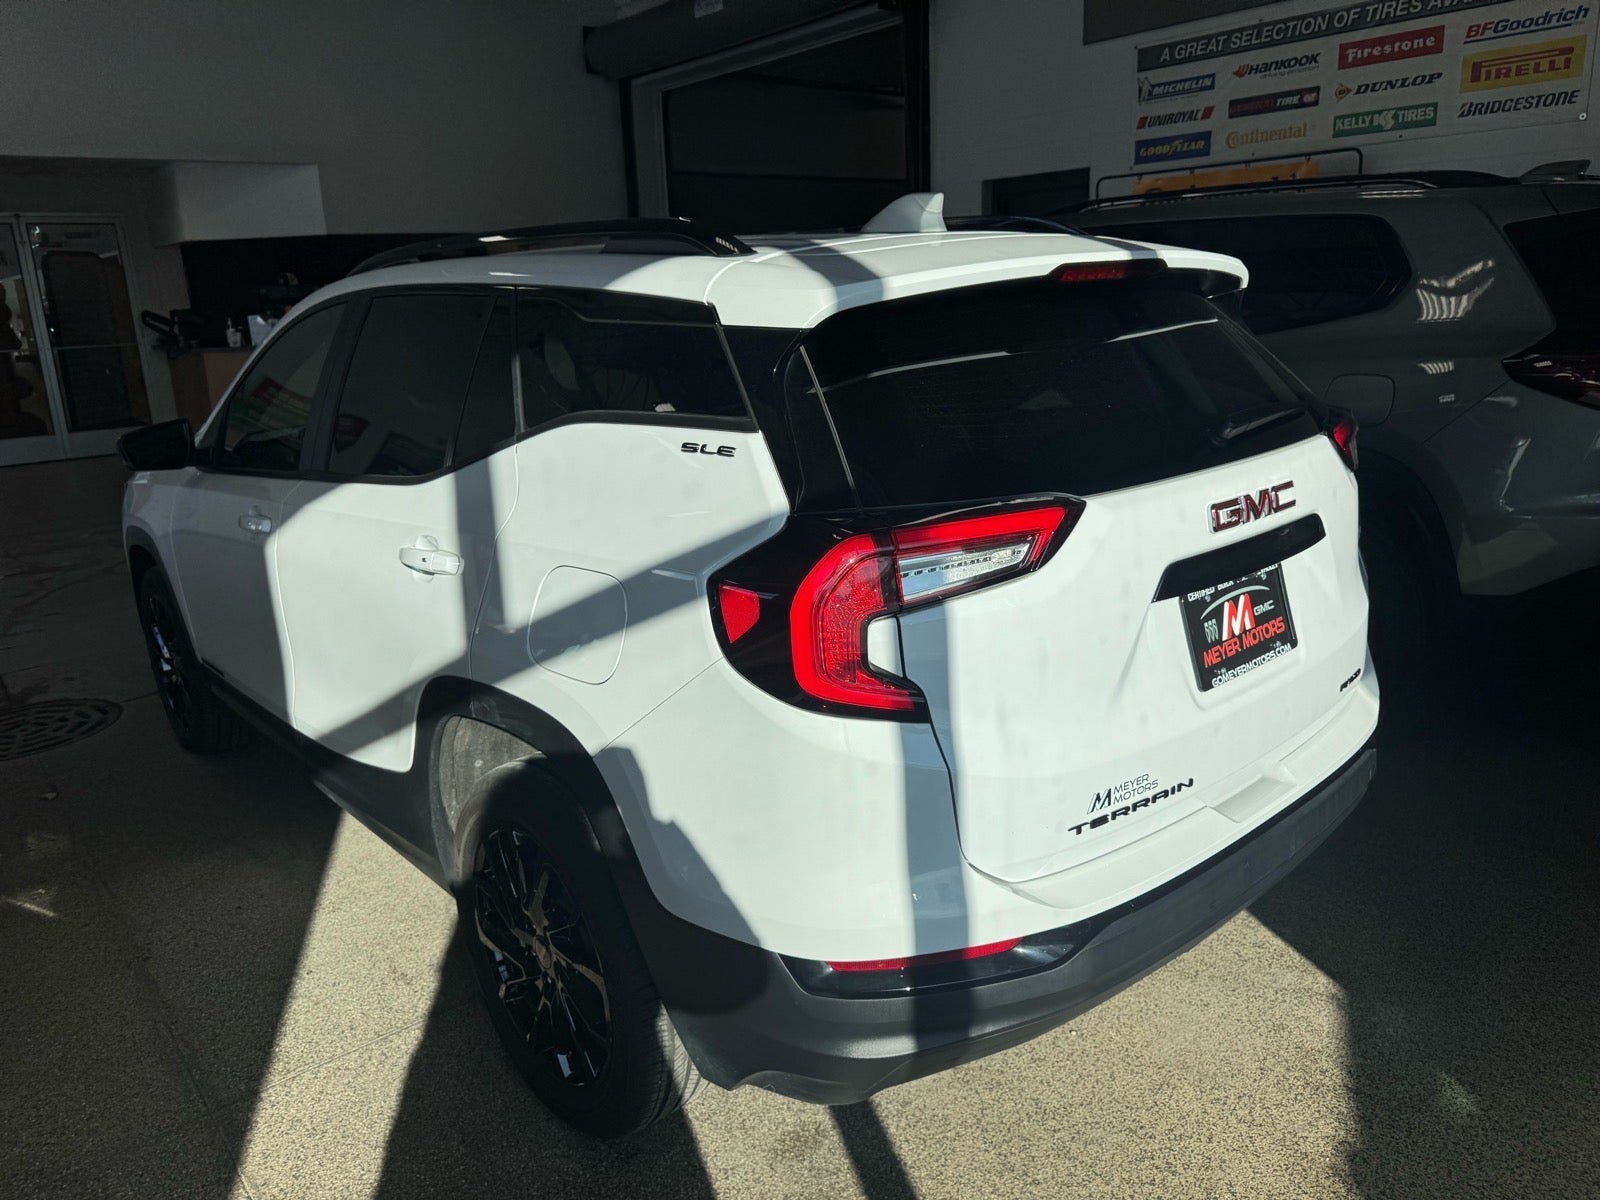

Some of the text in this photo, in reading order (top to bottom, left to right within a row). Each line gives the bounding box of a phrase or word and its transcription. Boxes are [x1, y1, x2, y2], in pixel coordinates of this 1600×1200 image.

[1159, 48, 1170, 63] A
[1174, 35, 1230, 59] GREAT
[1230, 14, 1329, 49] SELECTION
[1333, 8, 1360, 28] OF
[1366, 0, 1423, 22] TIRES
[1465, 5, 1589, 39] BFGoodrich
[1346, 34, 1436, 63] Firestone
[1470, 47, 1575, 83] PIRELLI
[1152, 76, 1213, 96] MICHELIN
[1354, 72, 1443, 95] DUNLOP
[1276, 94, 1301, 107] TIRE
[1457, 90, 1581, 118] BRIDGESTONE
[1148, 109, 1201, 128] UNIROYAL
[1335, 113, 1373, 131] KELLY
[1397, 107, 1435, 123] TIRES
[1139, 138, 1205, 158] GOODYEAR
[1225, 122, 1308, 149] Continental
[680, 442, 737, 458] SLE
[1209, 480, 1297, 533] GMC
[1254, 600, 1275, 616] GMC
[1203, 616, 1286, 668] MEYER MOTORS
[1211, 643, 1292, 688] GOMEYERMOTORS.COM
[1112, 773, 1150, 796] MEYER
[1112, 779, 1159, 806] MOTORS
[1067, 777, 1194, 836] TERRAIN
